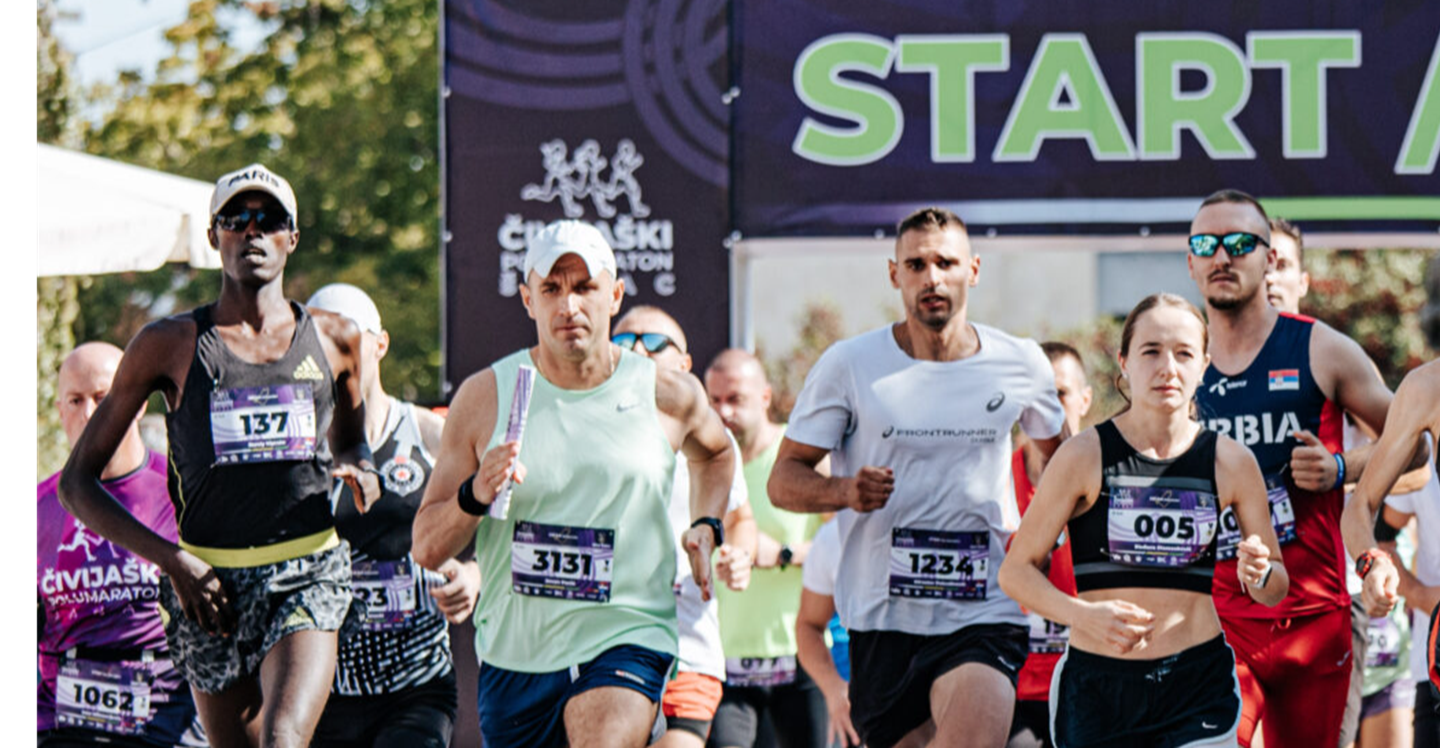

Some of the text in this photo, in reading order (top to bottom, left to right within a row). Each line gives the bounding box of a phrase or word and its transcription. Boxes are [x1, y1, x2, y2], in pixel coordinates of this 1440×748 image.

[793, 30, 1362, 167] START
[498, 213, 673, 250] ČIAŠKI
[239, 411, 289, 436] 137
[896, 429, 997, 437] FRONTRUNNER
[1199, 411, 1303, 446] RBIA
[1134, 514, 1194, 540] 005
[532, 549, 593, 576] 3131
[909, 552, 974, 576] 1234
[42, 558, 161, 595] ČIVIJAŠK
[48, 586, 160, 606] POLUMARATO
[354, 587, 388, 607] 23
[74, 683, 134, 711] 1062
